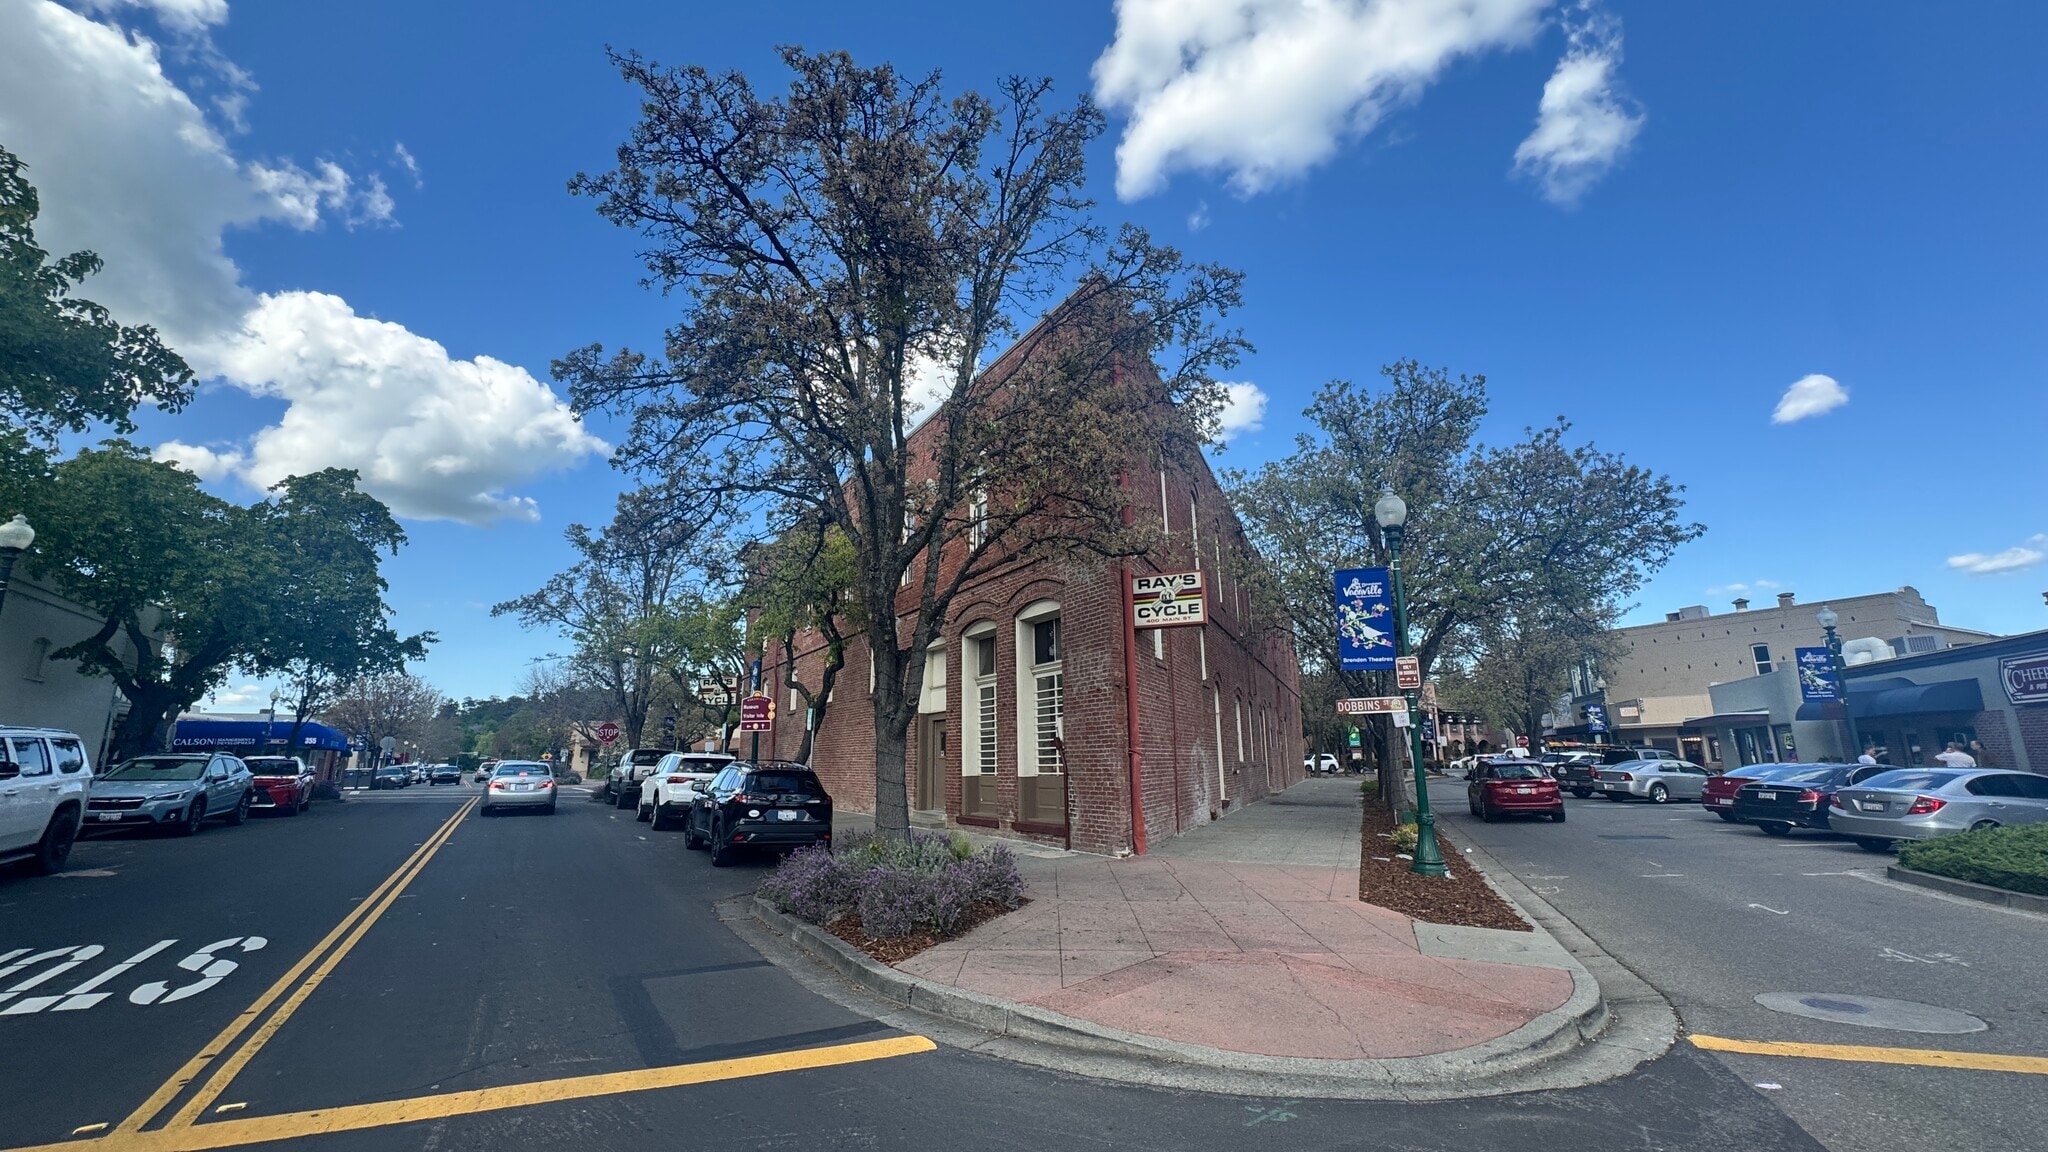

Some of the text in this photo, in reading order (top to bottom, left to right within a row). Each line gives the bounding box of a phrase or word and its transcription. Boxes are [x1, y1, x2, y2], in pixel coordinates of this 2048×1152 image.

[1137, 574, 1197, 590] RAY'S
[1342, 584, 1383, 597] Vacaville
[1137, 603, 1200, 619] CYCLE
[1337, 700, 1380, 712] DOBBINS
[600, 728, 618, 737] STOP
[173, 738, 215, 746] CALSON
